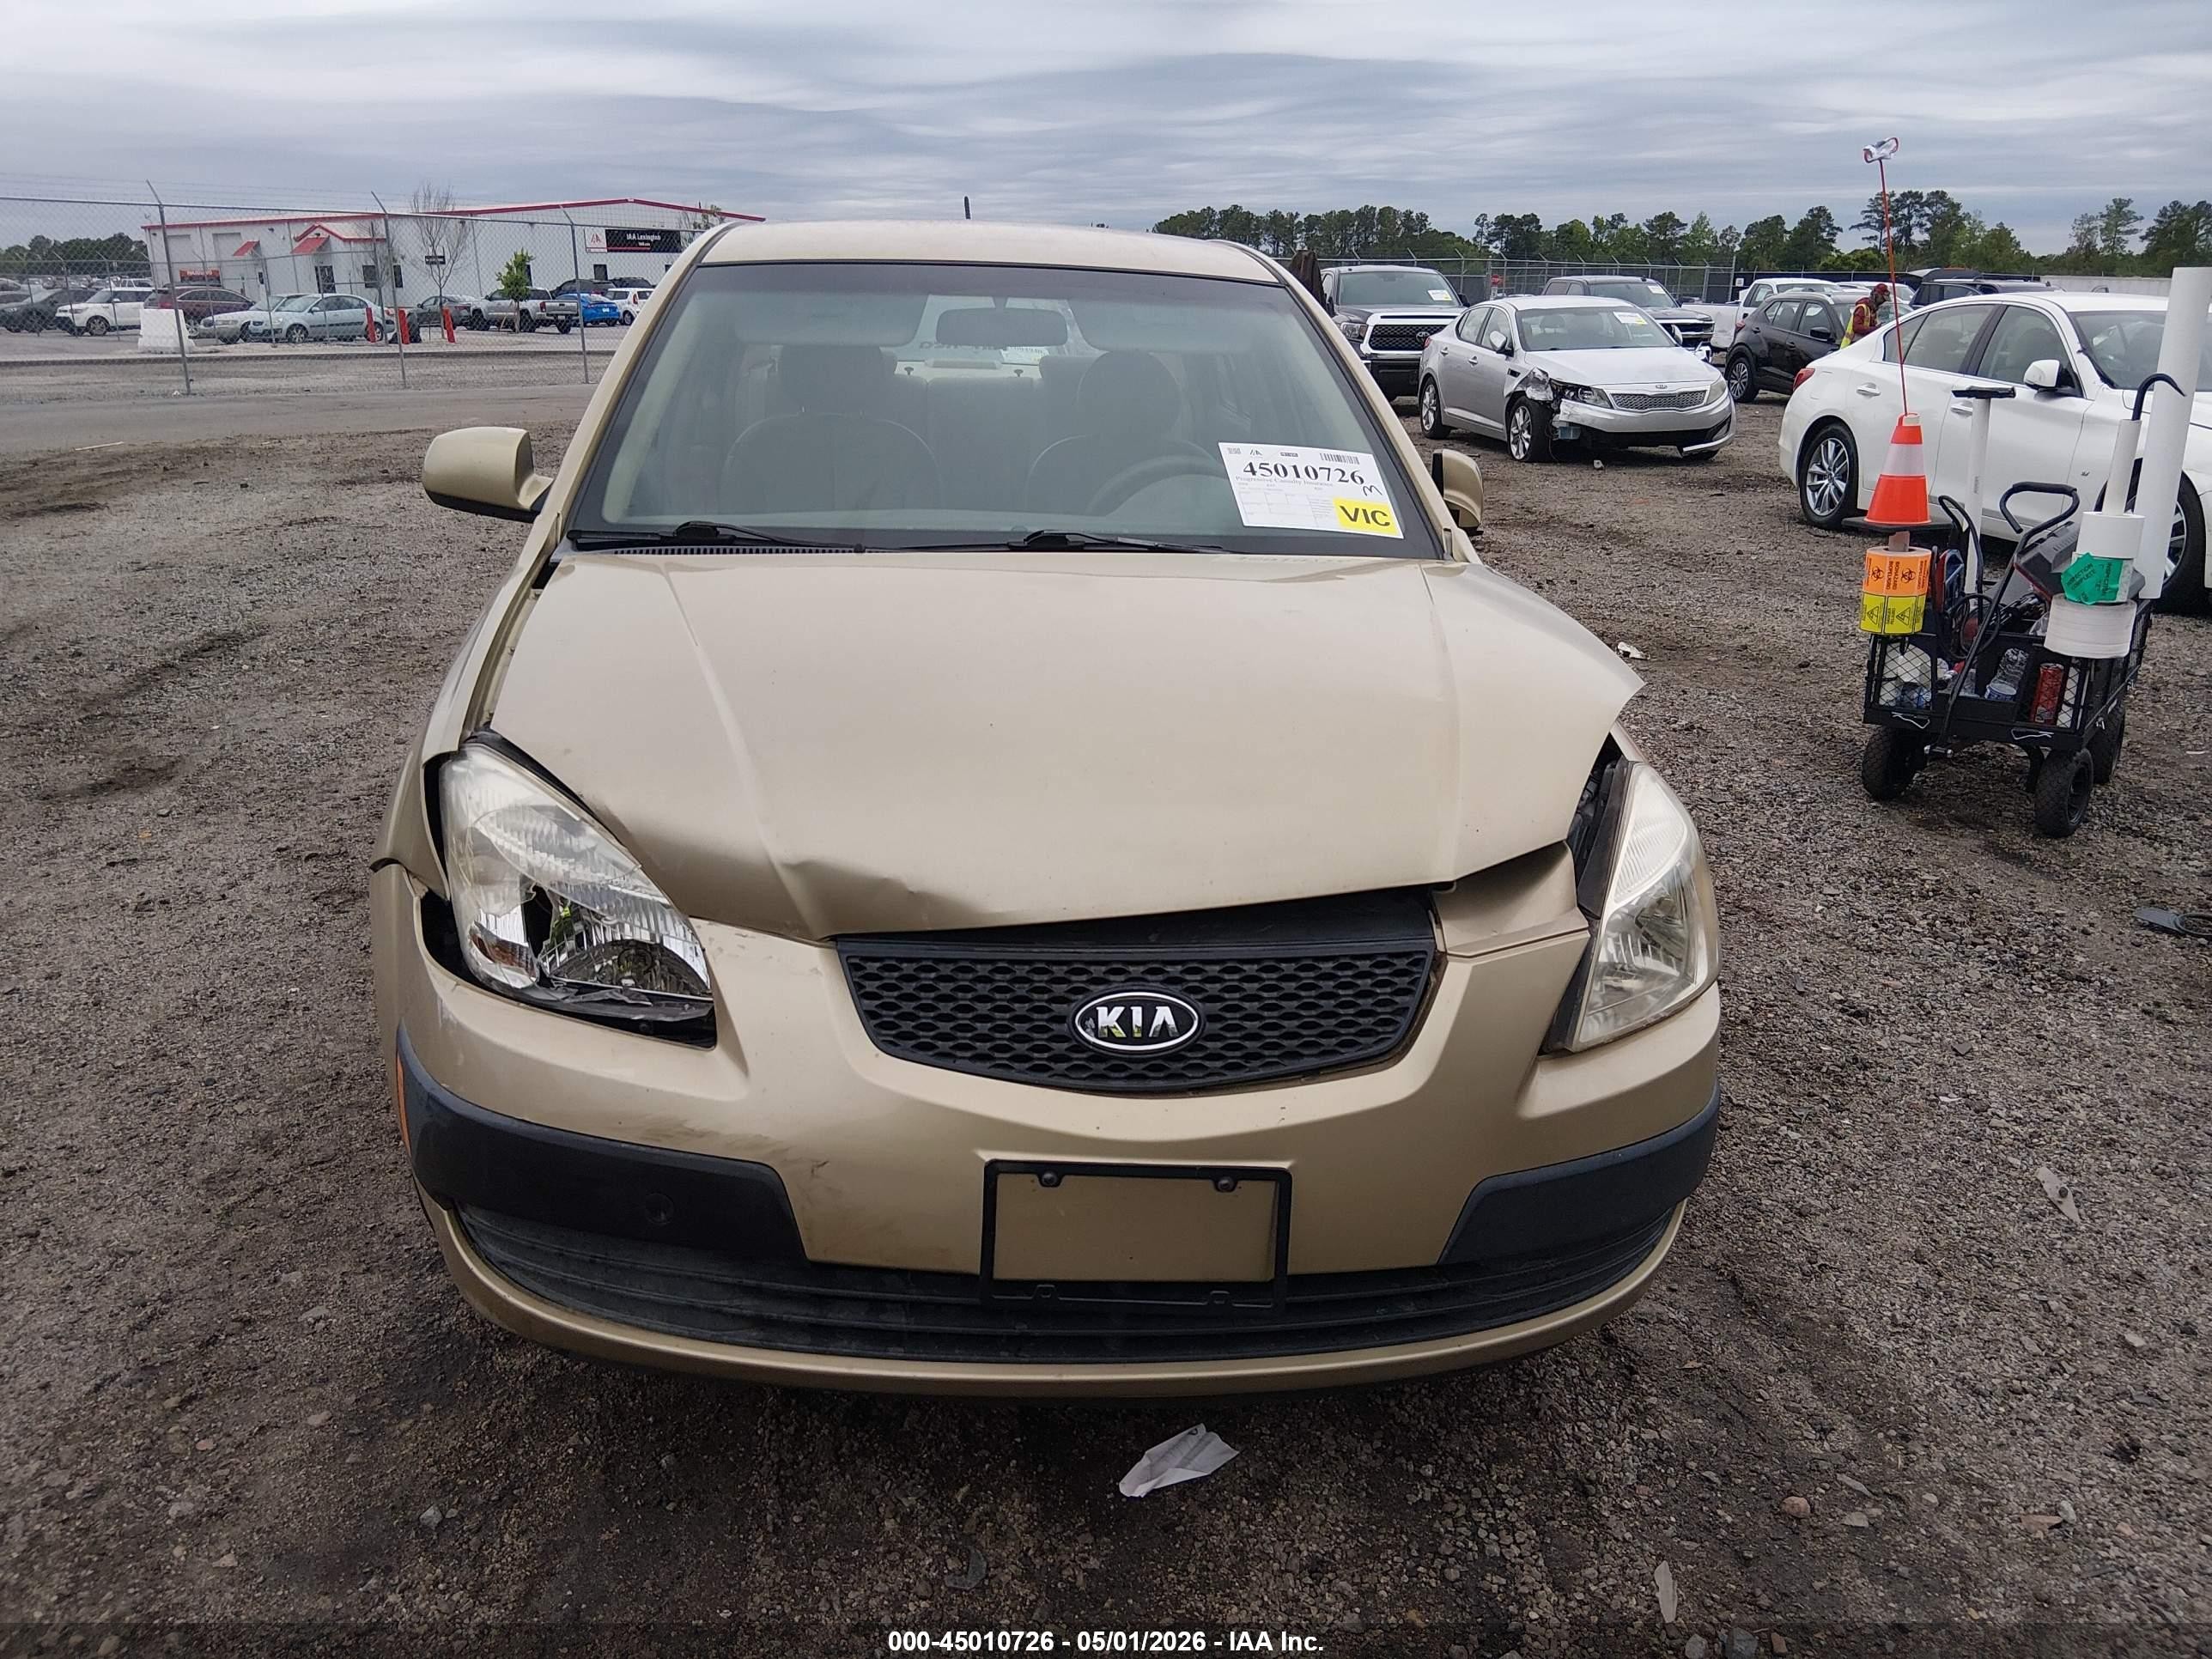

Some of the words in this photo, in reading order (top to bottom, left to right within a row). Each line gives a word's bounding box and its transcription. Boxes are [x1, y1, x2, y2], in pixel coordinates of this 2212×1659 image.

[637, 233, 661, 241] Lexington
[1243, 461, 1364, 485] 45010726
[1340, 505, 1390, 526] VIC
[1097, 1006, 1180, 1038] KIA
